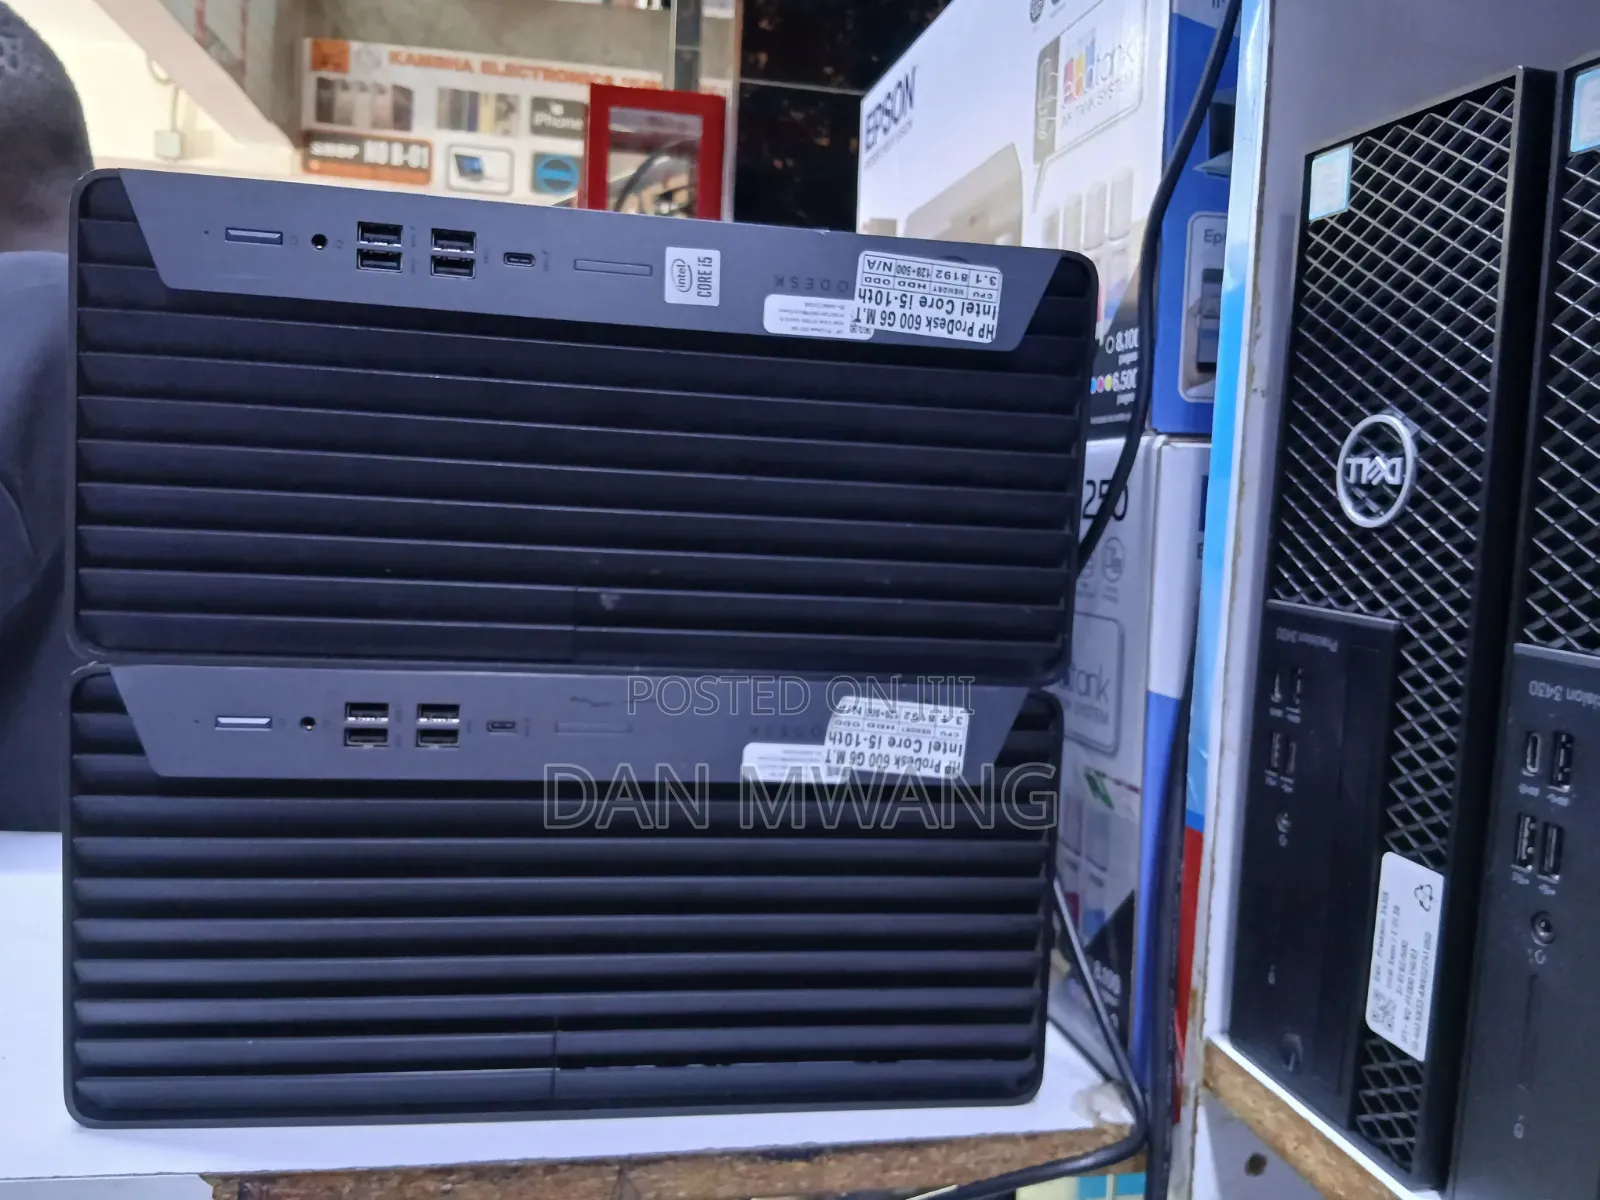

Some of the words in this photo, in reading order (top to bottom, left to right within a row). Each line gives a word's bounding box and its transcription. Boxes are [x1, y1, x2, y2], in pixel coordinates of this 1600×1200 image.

[865, 66, 916, 153] EPSON
[533, 113, 583, 130] iPhone
[1204, 229, 1226, 247] Ep
[697, 256, 713, 268] i5
[866, 258, 893, 272] N/A
[676, 264, 686, 288] intel
[697, 269, 713, 298] CORE
[864, 276, 891, 286] ODD
[897, 280, 927, 290] HDD
[935, 269, 968, 283] 8192
[975, 273, 997, 286] 3.1
[858, 287, 914, 310] i5-10th
[933, 286, 964, 296] MEMORY
[918, 295, 955, 316] Core
[961, 301, 997, 320] Intel
[853, 306, 876, 326] M.T
[880, 310, 896, 327] G6
[900, 313, 922, 331] 600
[925, 316, 975, 337] ProDesk
[977, 323, 995, 340] HP
[1345, 456, 1403, 485] DELL
[1528, 680, 1563, 701] 3430
[887, 736, 922, 754] Core
[927, 740, 963, 757] Intel
[850, 750, 866, 767] G6
[868, 752, 890, 769] 600
[894, 756, 942, 774] ProDesk
